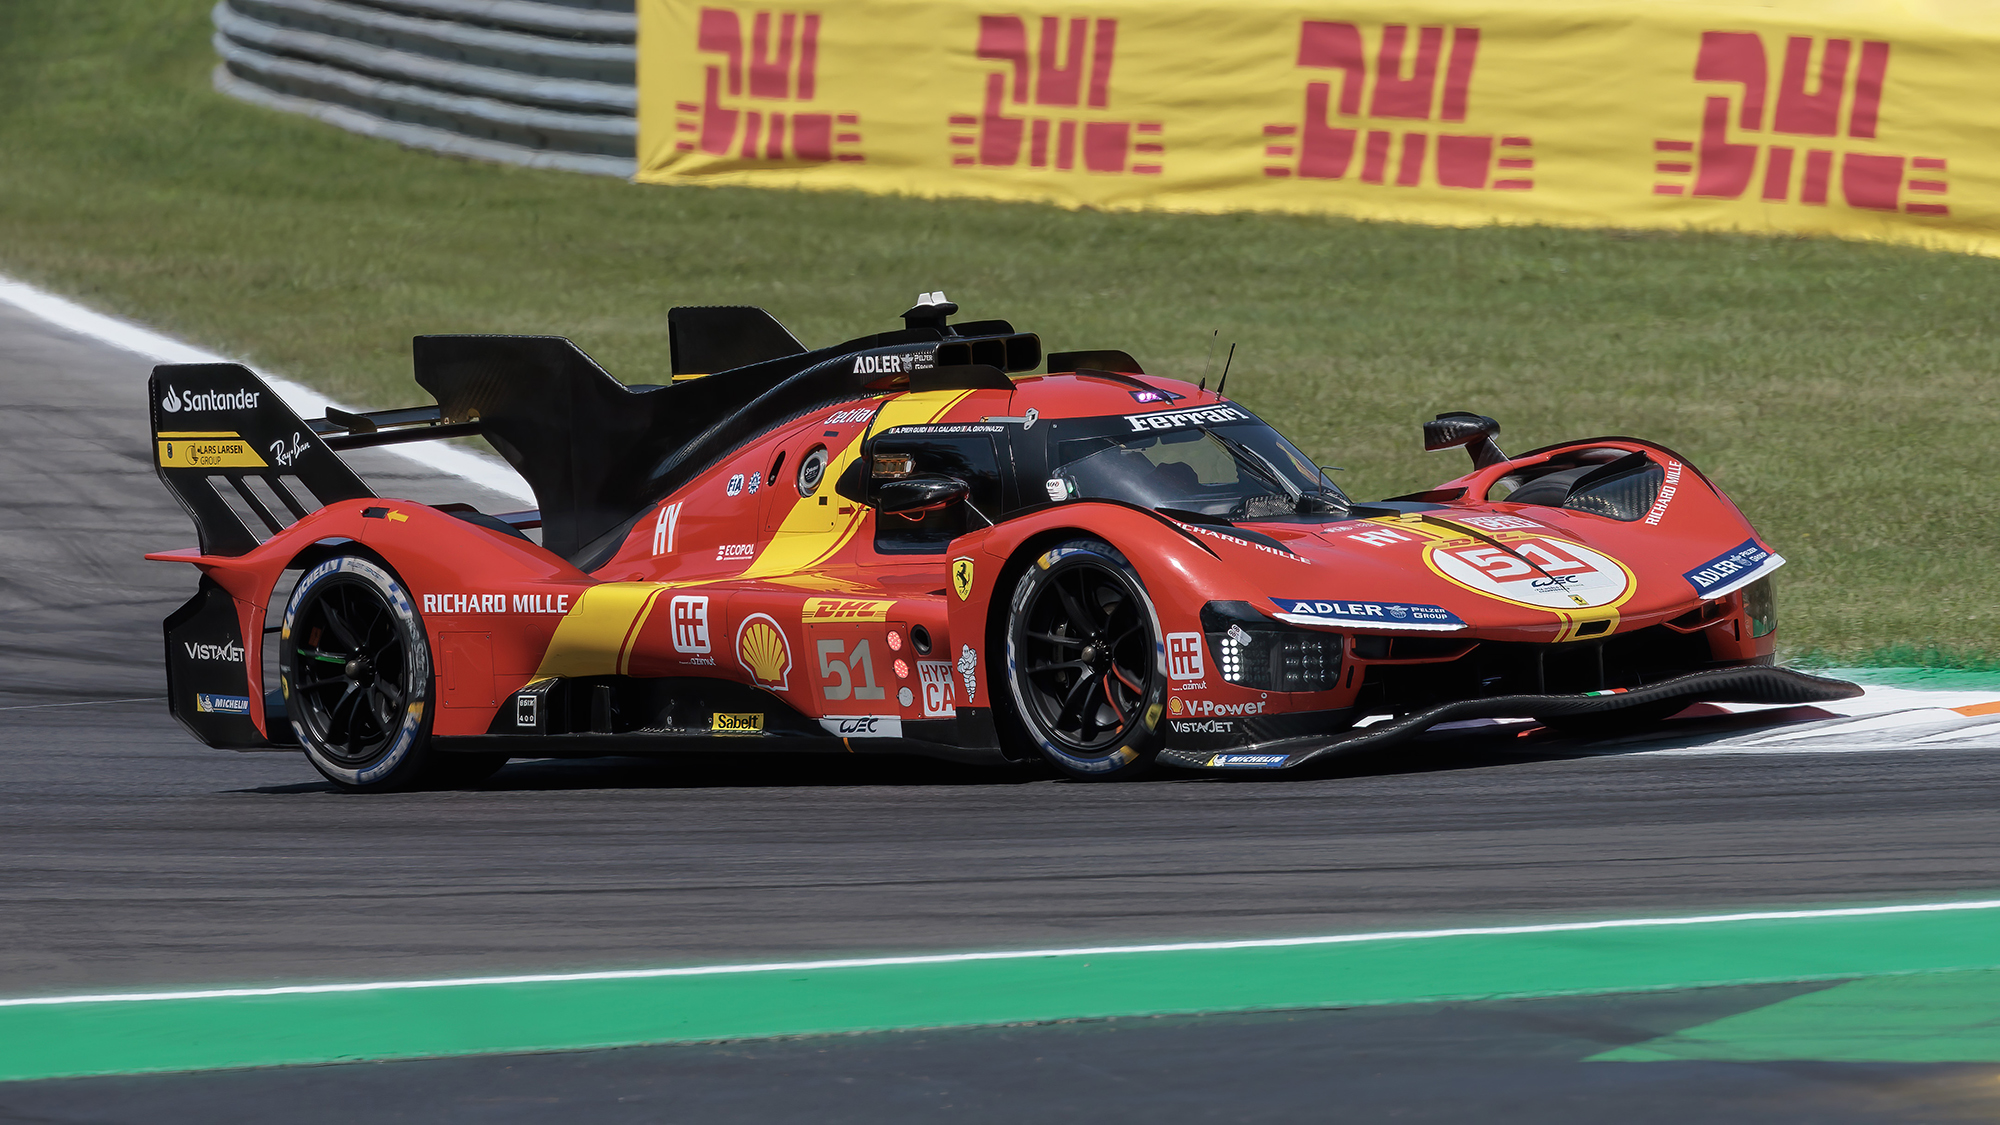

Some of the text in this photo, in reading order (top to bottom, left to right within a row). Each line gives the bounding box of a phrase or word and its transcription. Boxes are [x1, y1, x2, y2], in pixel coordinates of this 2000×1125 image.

[698, 8, 832, 160] DHL
[976, 15, 1130, 172] DHL
[1296, 21, 1493, 188] DHL
[1693, 31, 1905, 210] DHL
[853, 355, 900, 374] ADLER
[183, 388, 260, 412] Santander
[1123, 404, 1250, 432] Ferrari
[199, 445, 243, 454] LARS LARSEN
[200, 456, 221, 465] GROUP
[727, 477, 744, 493] FIA
[1645, 460, 1683, 526] RICHARD MILLE
[652, 501, 684, 556] HY
[1346, 529, 1412, 547] HY
[724, 543, 754, 556] ECOPOL
[1255, 543, 1312, 565] MILLE
[1455, 543, 1586, 578] 51
[1691, 560, 1743, 588] ADLER
[423, 594, 569, 613] RICHARD MILLE
[813, 600, 879, 618] DHL
[1291, 602, 1385, 617] ADLER
[1413, 612, 1448, 620] GROUP
[816, 638, 886, 701] 51
[1182, 680, 1208, 690] azimut
[214, 698, 249, 710] MICHELIN
[1185, 700, 1267, 717] V-Power
[519, 714, 534, 722] 400
[717, 714, 759, 729] Sabelt
[839, 717, 879, 733] WEC
[1227, 755, 1285, 763] MICHELIN
